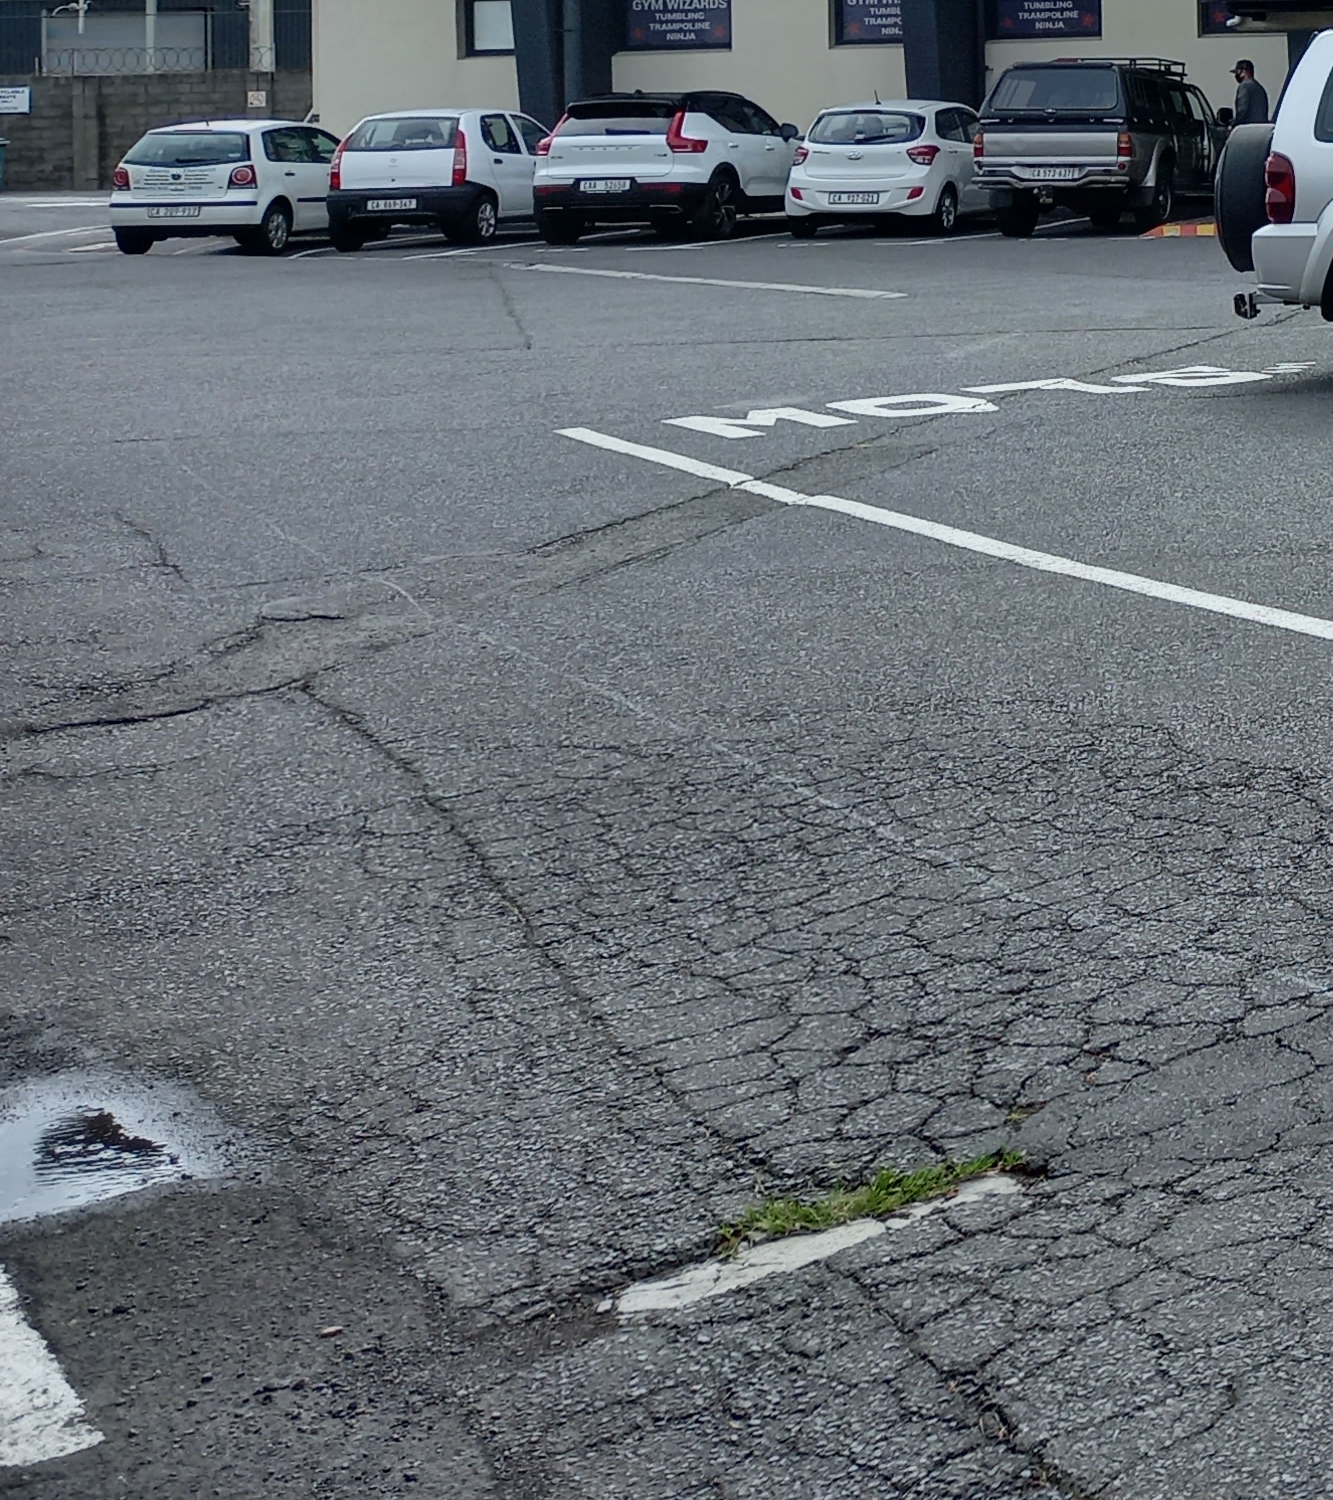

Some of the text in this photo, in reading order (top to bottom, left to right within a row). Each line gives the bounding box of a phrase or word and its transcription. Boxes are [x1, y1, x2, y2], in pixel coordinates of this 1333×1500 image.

[632, 0, 664, 11] GYM
[1023, 1, 1073, 10] TUMBLING
[654, 12, 705, 20] TUMBLING
[1018, 11, 1079, 20] TRAMPOLINE
[649, 22, 711, 31] TRAMPOLINE
[1035, 21, 1065, 29] NINJA
[666, 32, 696, 40] NINJA
